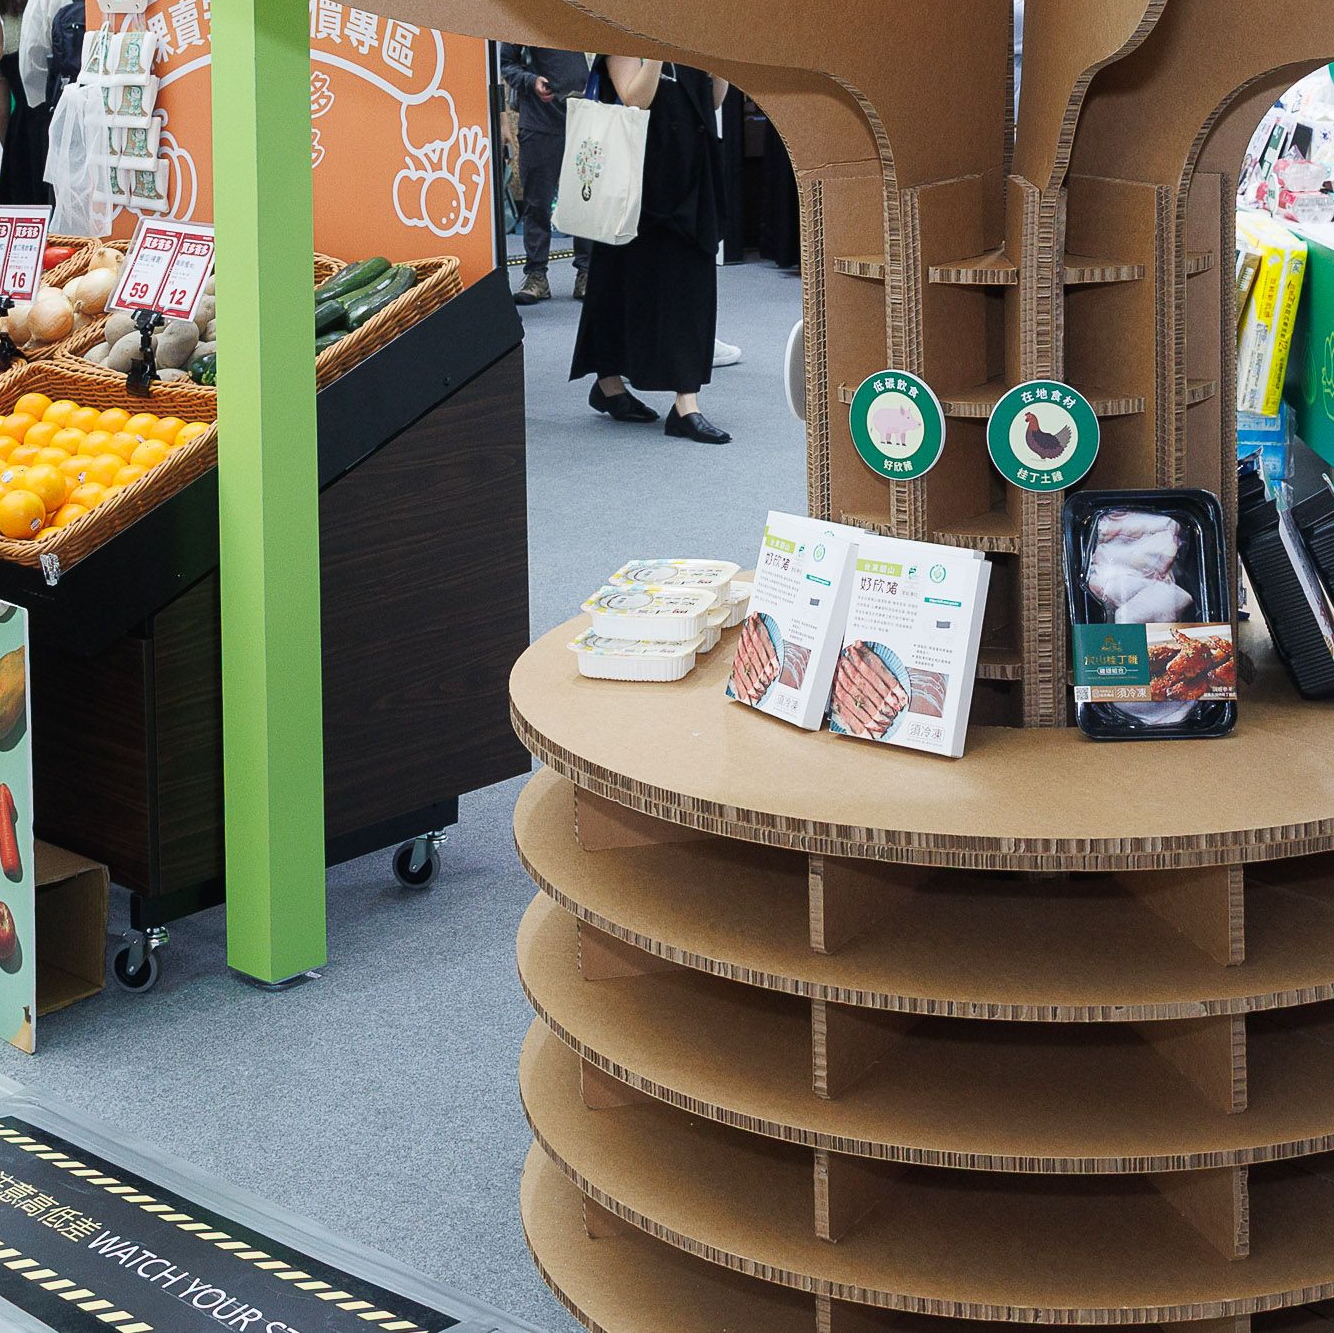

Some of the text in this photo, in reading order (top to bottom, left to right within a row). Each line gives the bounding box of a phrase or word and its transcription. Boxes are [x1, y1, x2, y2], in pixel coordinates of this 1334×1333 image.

[12, 272, 26, 288] 16
[129, 282, 149, 299] 59
[169, 288, 187, 306] 12
[873, 377, 919, 399] 低碳飲食
[1021, 388, 1078, 409] 在地食材
[883, 459, 913, 472] 好欣豬
[1017, 468, 1064, 484] 桂丁土雞
[860, 577, 899, 595] 好欣豬
[1117, 688, 1147, 698] 須冷凍
[89, 1230, 189, 1291] WATCH
[178, 1277, 263, 1332] YOUR
